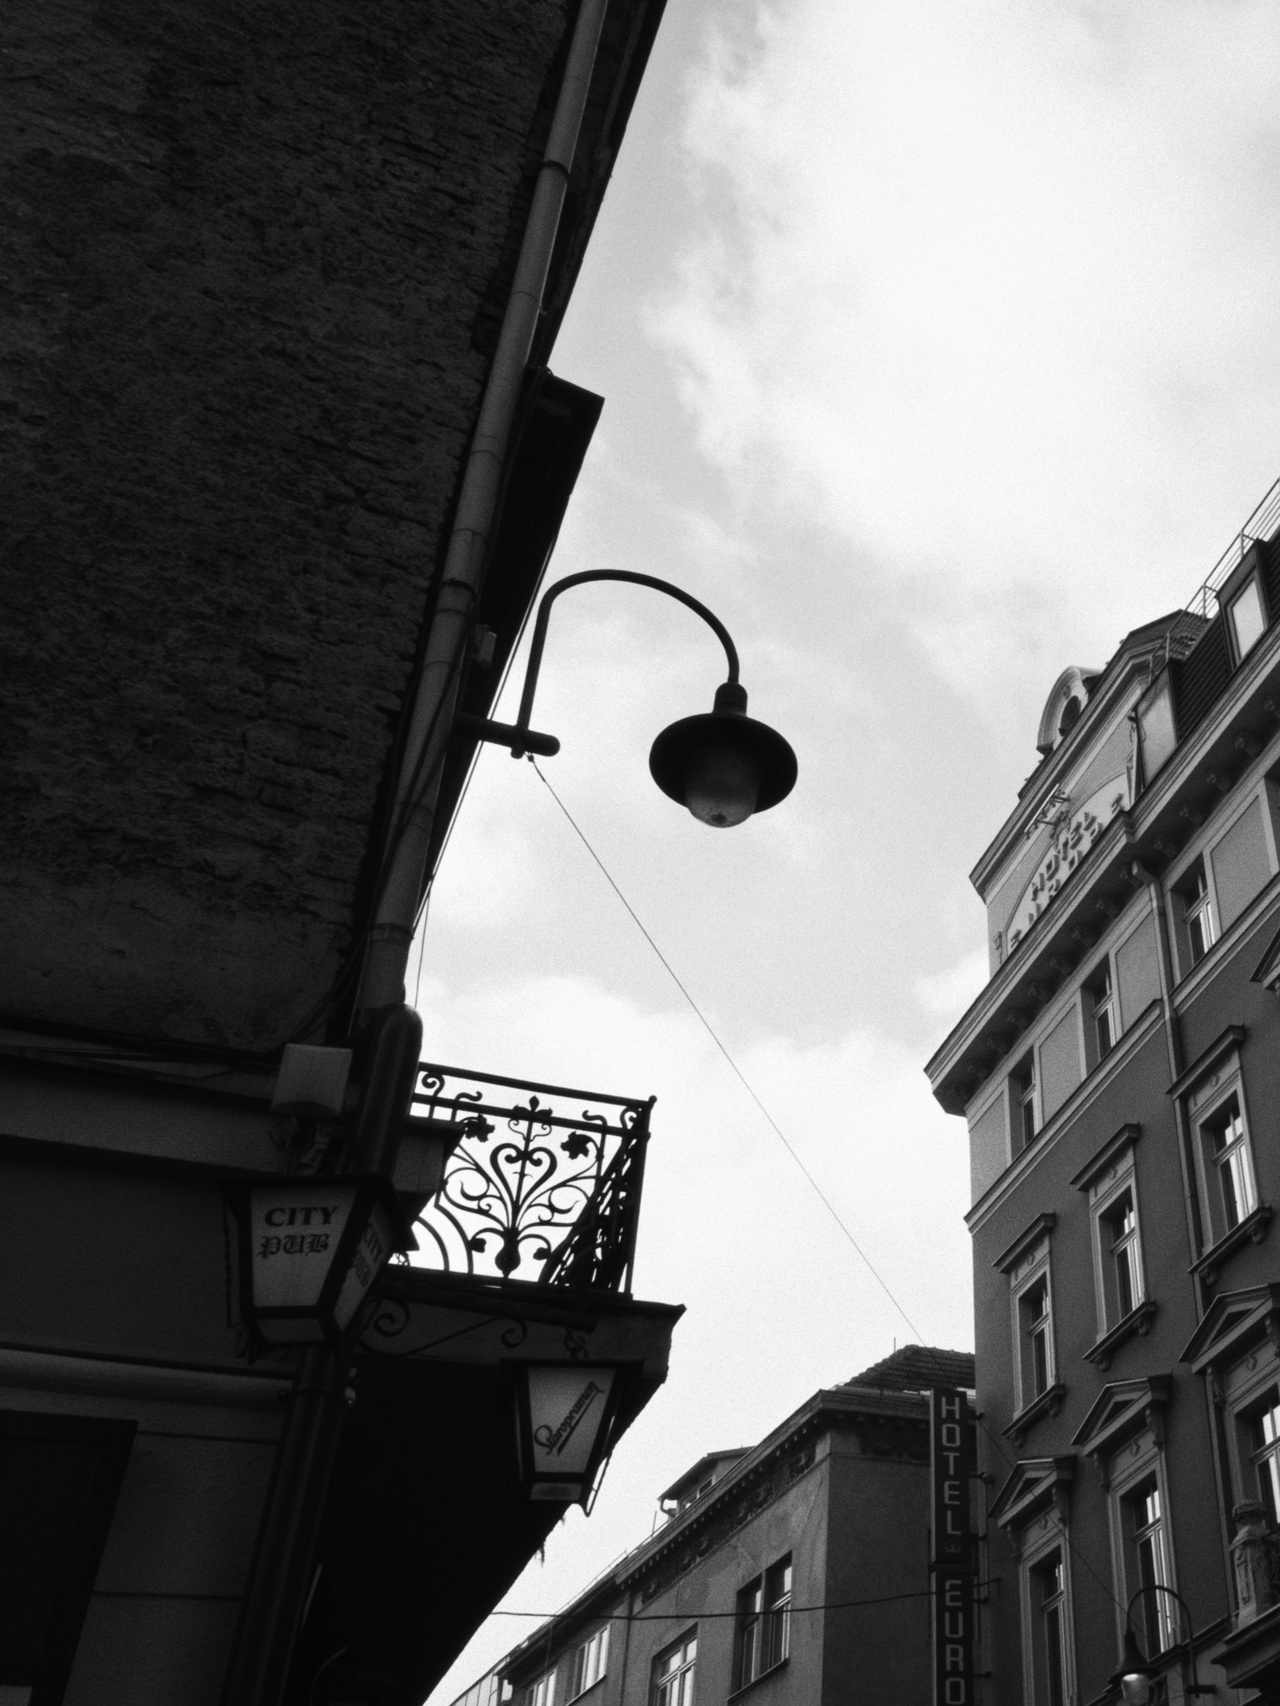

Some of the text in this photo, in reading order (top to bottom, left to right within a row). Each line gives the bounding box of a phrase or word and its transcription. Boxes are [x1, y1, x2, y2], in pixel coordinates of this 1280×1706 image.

[1029, 812, 1097, 902] HOTEL
[264, 1206, 339, 1227] CITY
[533, 1380, 605, 1456] Staropramen
[940, 1396, 962, 1536] HOTEL
